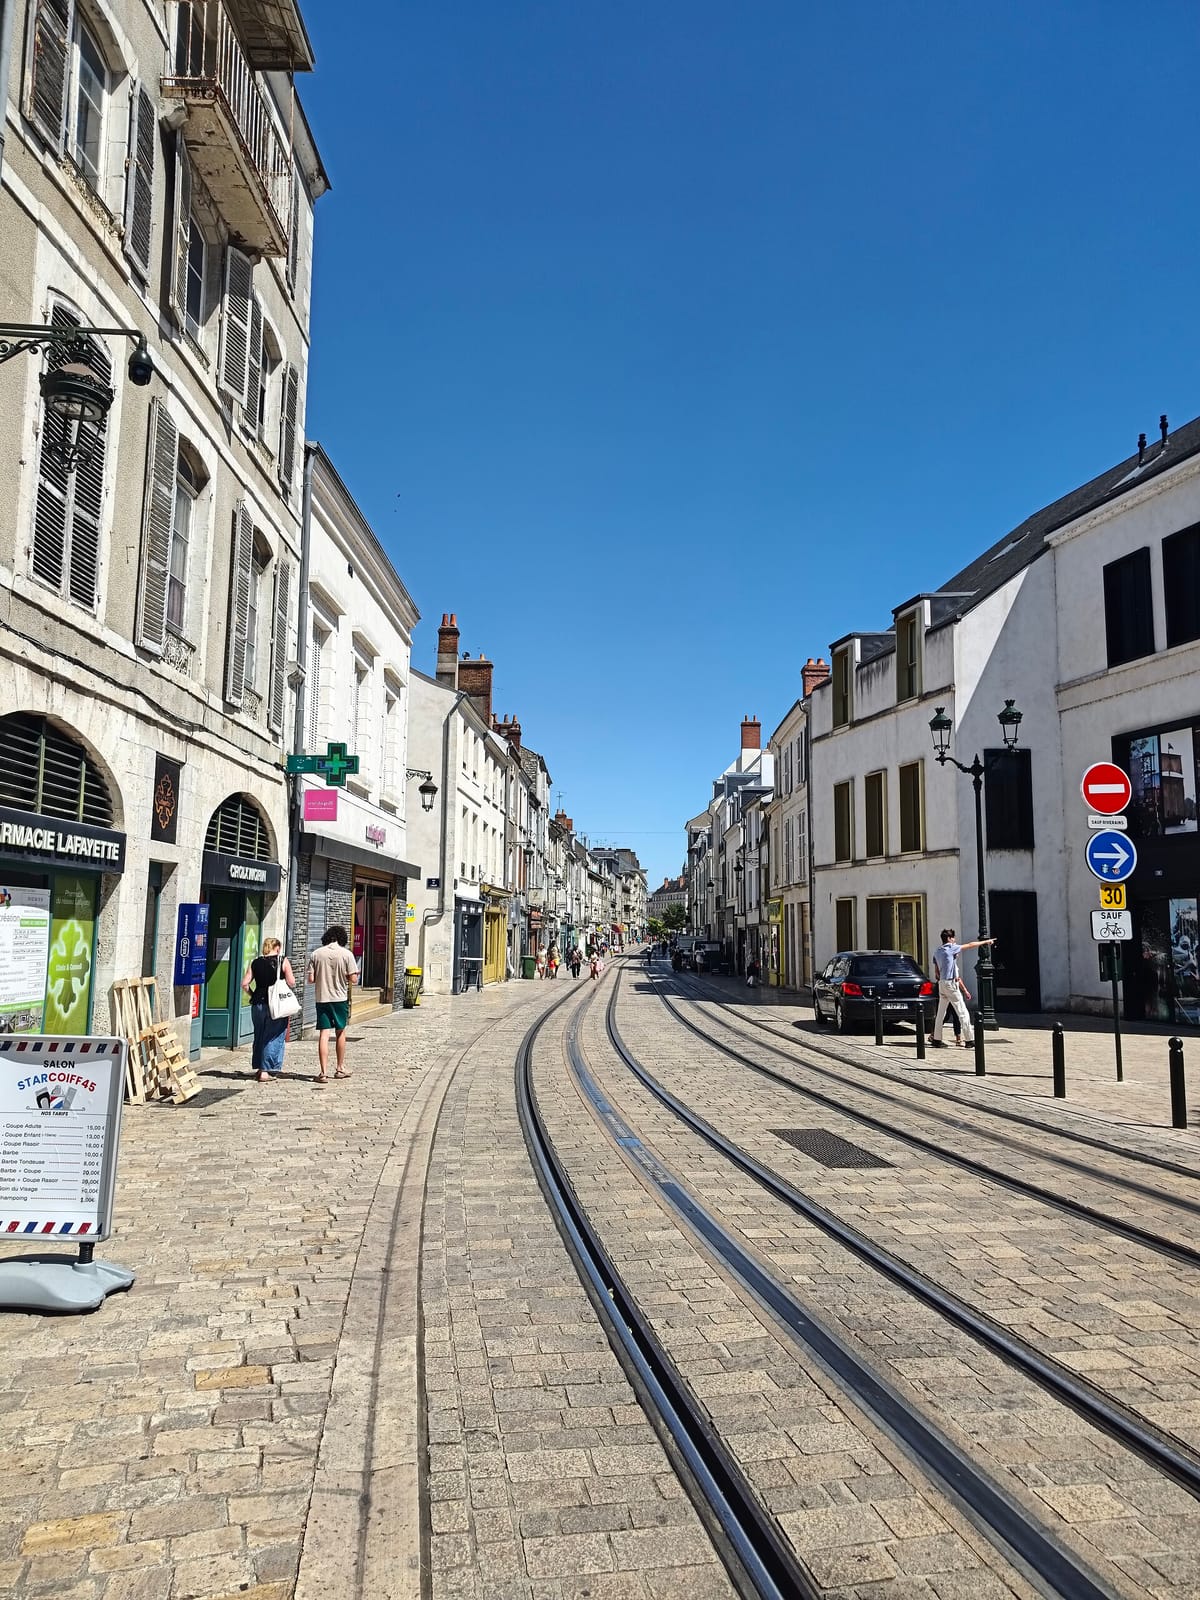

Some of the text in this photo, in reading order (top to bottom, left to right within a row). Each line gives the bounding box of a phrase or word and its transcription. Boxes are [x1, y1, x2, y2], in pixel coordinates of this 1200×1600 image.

[56, 832, 120, 860] LAFAYETTE
[1104, 887, 1122, 904] 30
[1100, 912, 1122, 920] SAUF
[43, 1060, 75, 1068] SALON
[17, 1072, 96, 1092] STARCOIFF45
